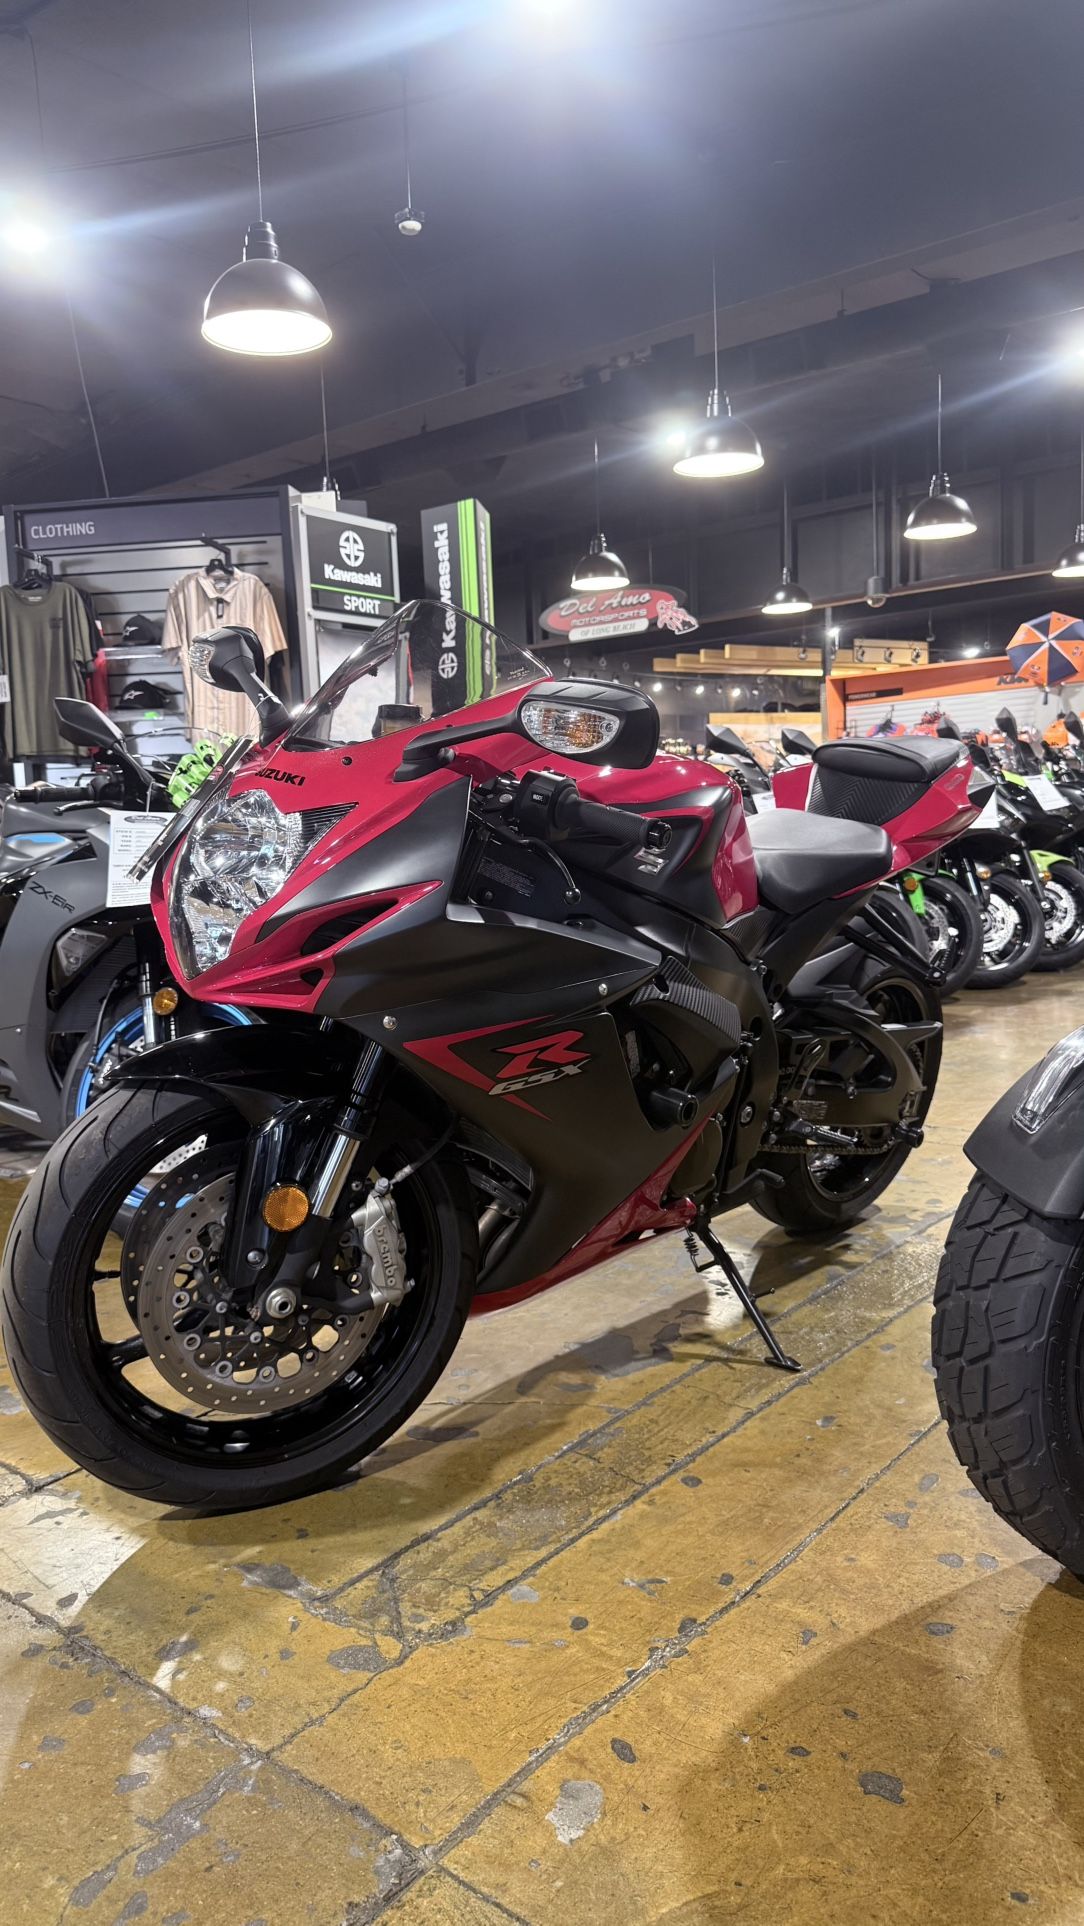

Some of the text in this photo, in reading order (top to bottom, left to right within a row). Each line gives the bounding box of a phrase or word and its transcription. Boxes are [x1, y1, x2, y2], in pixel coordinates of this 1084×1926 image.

[31, 522, 95, 539] CLOTHING
[324, 563, 382, 588] Kawasaki
[433, 522, 457, 648] Kawasaki
[344, 595, 381, 615] SPORT
[559, 591, 652, 617] Del Amo
[571, 609, 648, 627] MOTORSPORTS
[254, 767, 306, 786] UZUKI
[375, 1225, 398, 1286] brembo
